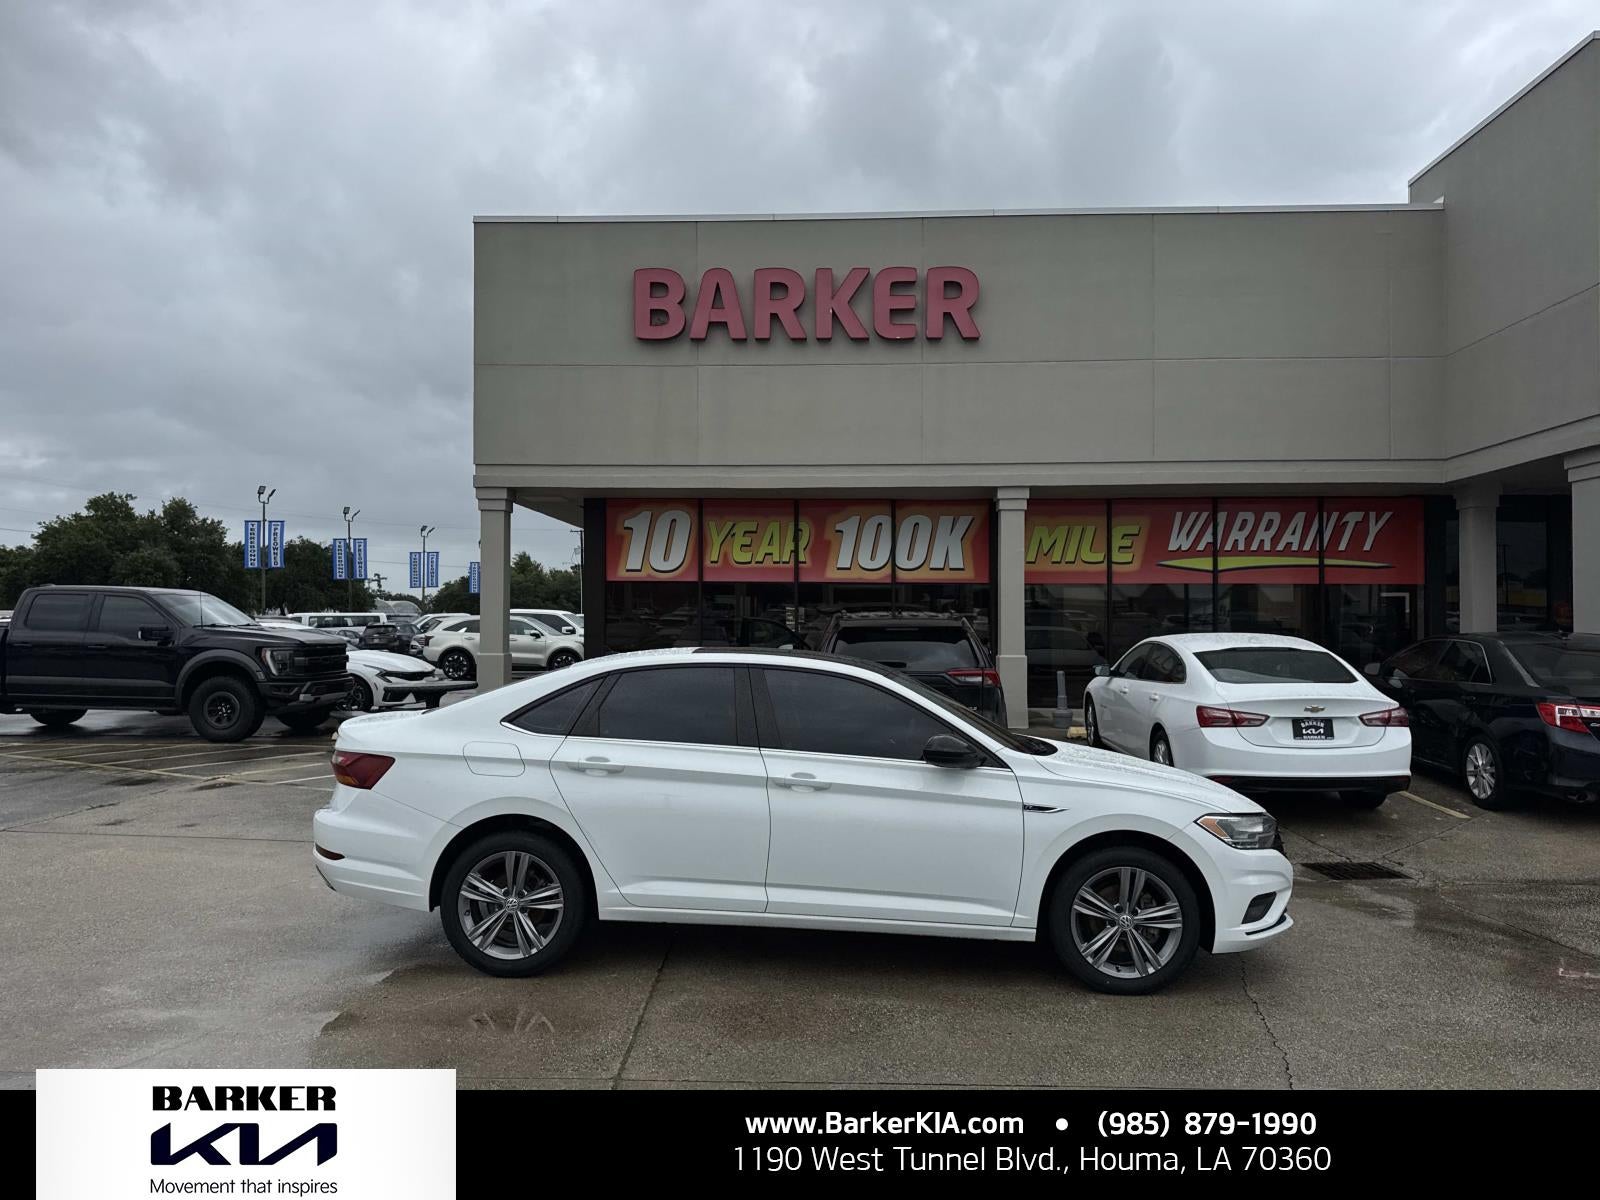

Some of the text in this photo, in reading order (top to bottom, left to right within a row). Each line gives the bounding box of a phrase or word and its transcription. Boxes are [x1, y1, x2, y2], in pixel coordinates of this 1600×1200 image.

[633, 266, 981, 341] BARKER
[623, 509, 1394, 573] 10 YEAR 100K MILE WARRANTY
